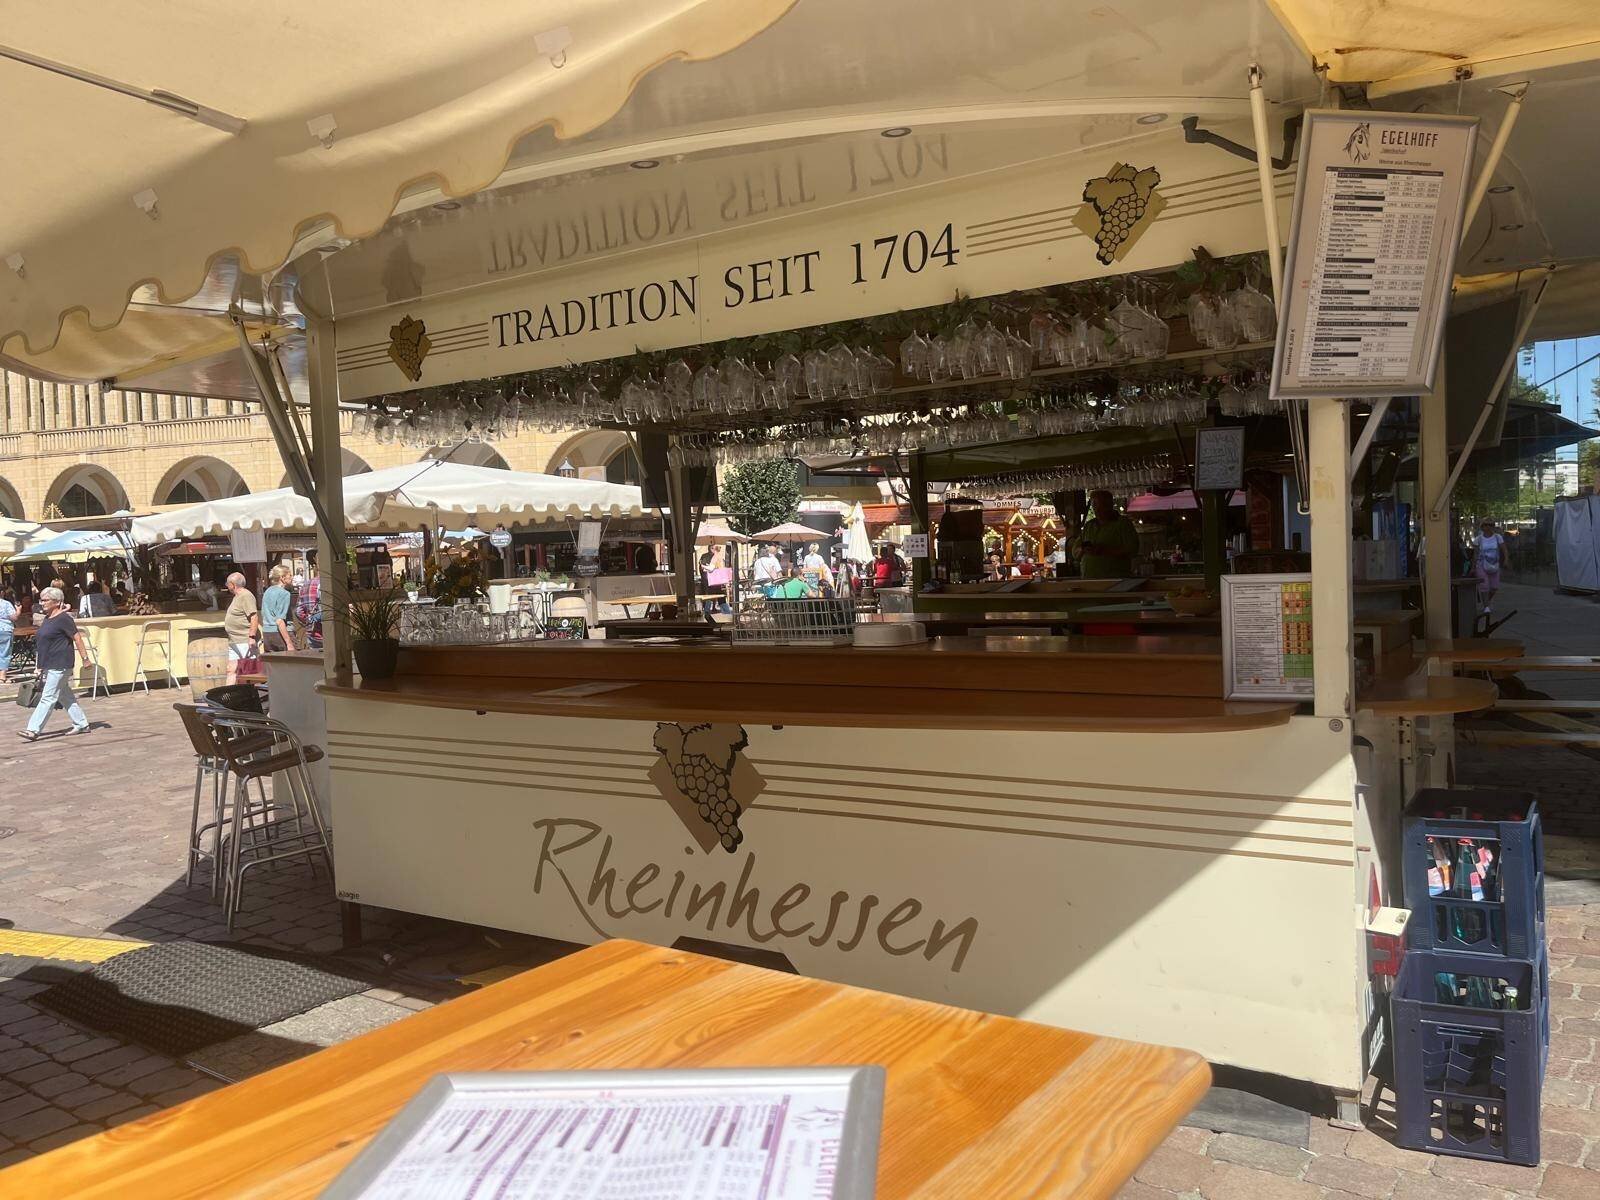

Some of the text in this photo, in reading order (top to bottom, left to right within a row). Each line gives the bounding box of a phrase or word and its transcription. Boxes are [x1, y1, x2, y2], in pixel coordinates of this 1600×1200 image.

[1381, 130, 1439, 147] EGELHOFF
[492, 223, 960, 348] TRADITION SEIT 1704
[532, 818, 979, 973] Rheinhessen
